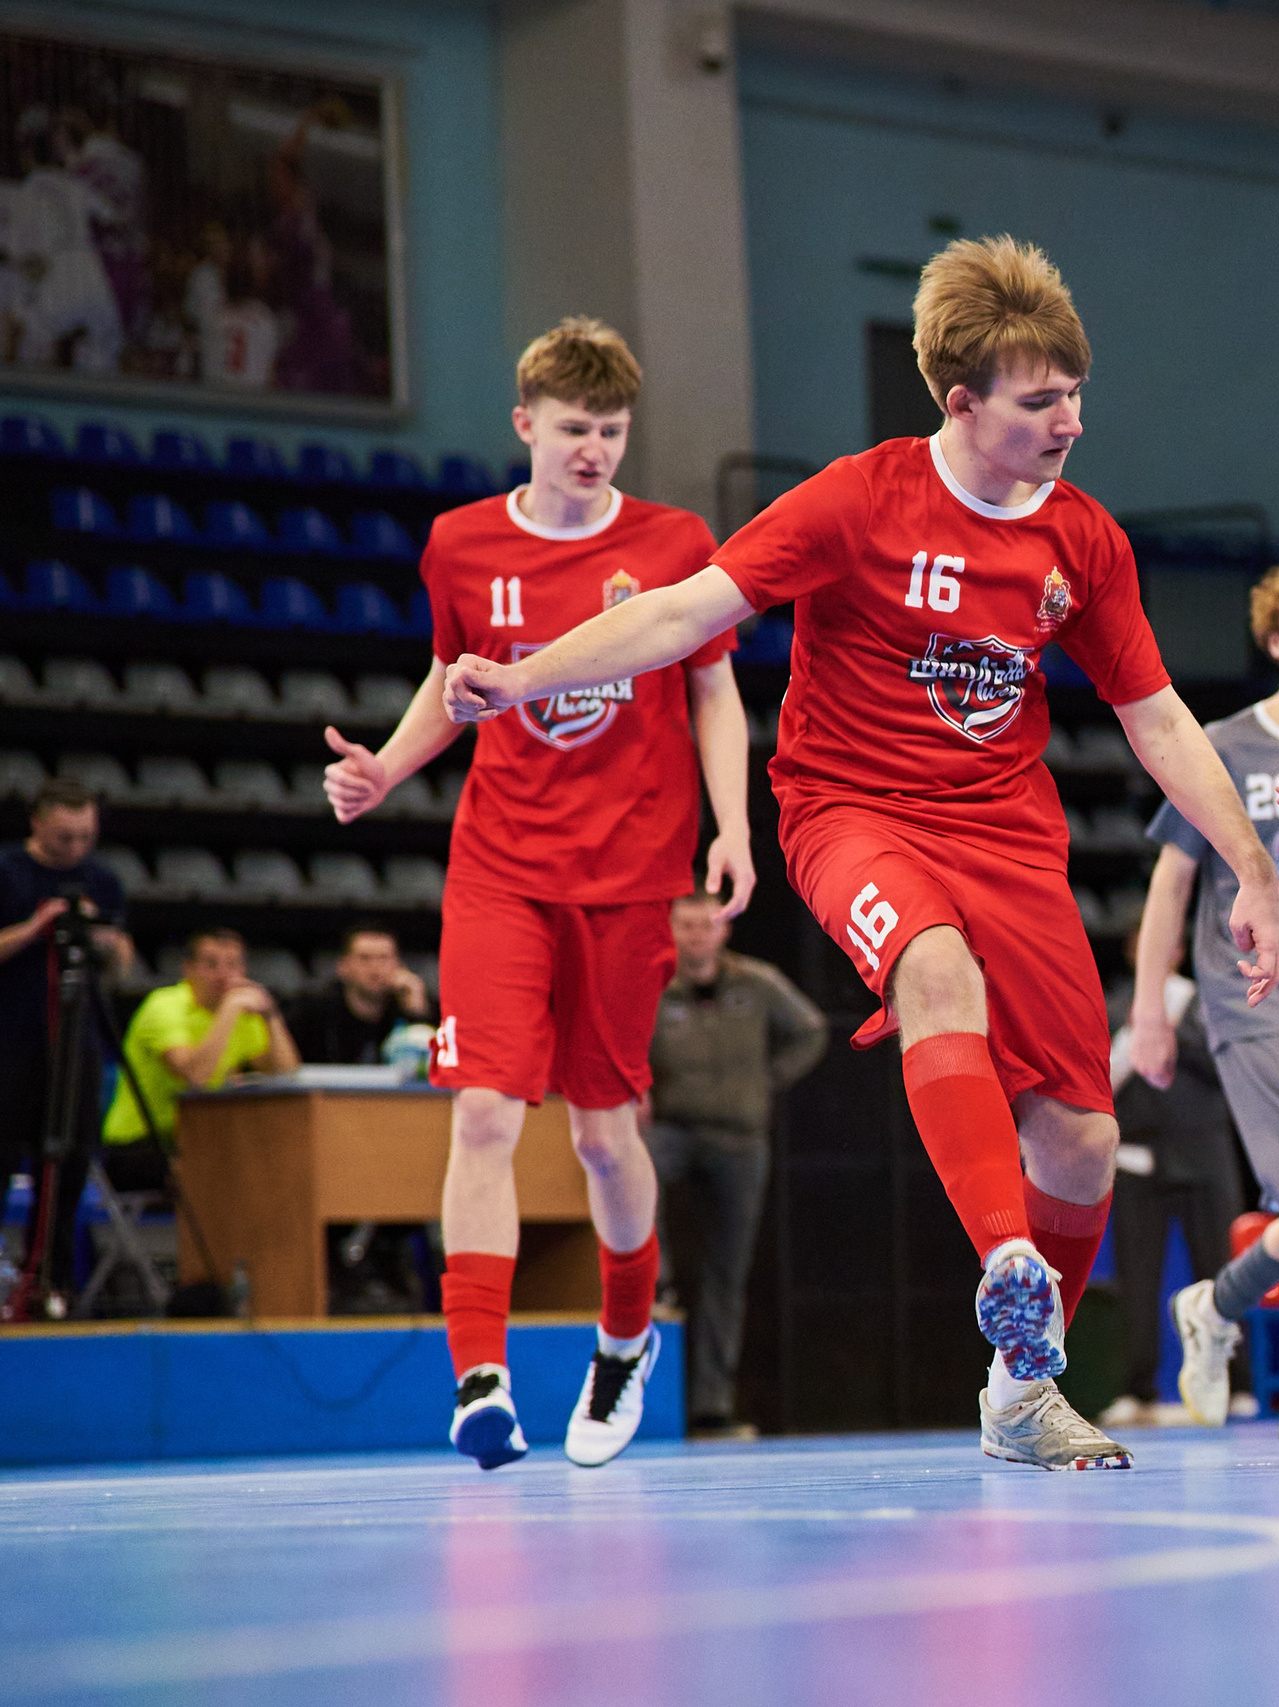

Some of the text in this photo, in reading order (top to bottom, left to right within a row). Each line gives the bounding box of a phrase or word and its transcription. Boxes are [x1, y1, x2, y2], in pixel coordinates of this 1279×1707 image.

[490, 577, 524, 627] 11
[905, 551, 965, 613] 16
[846, 882, 899, 972] 16
